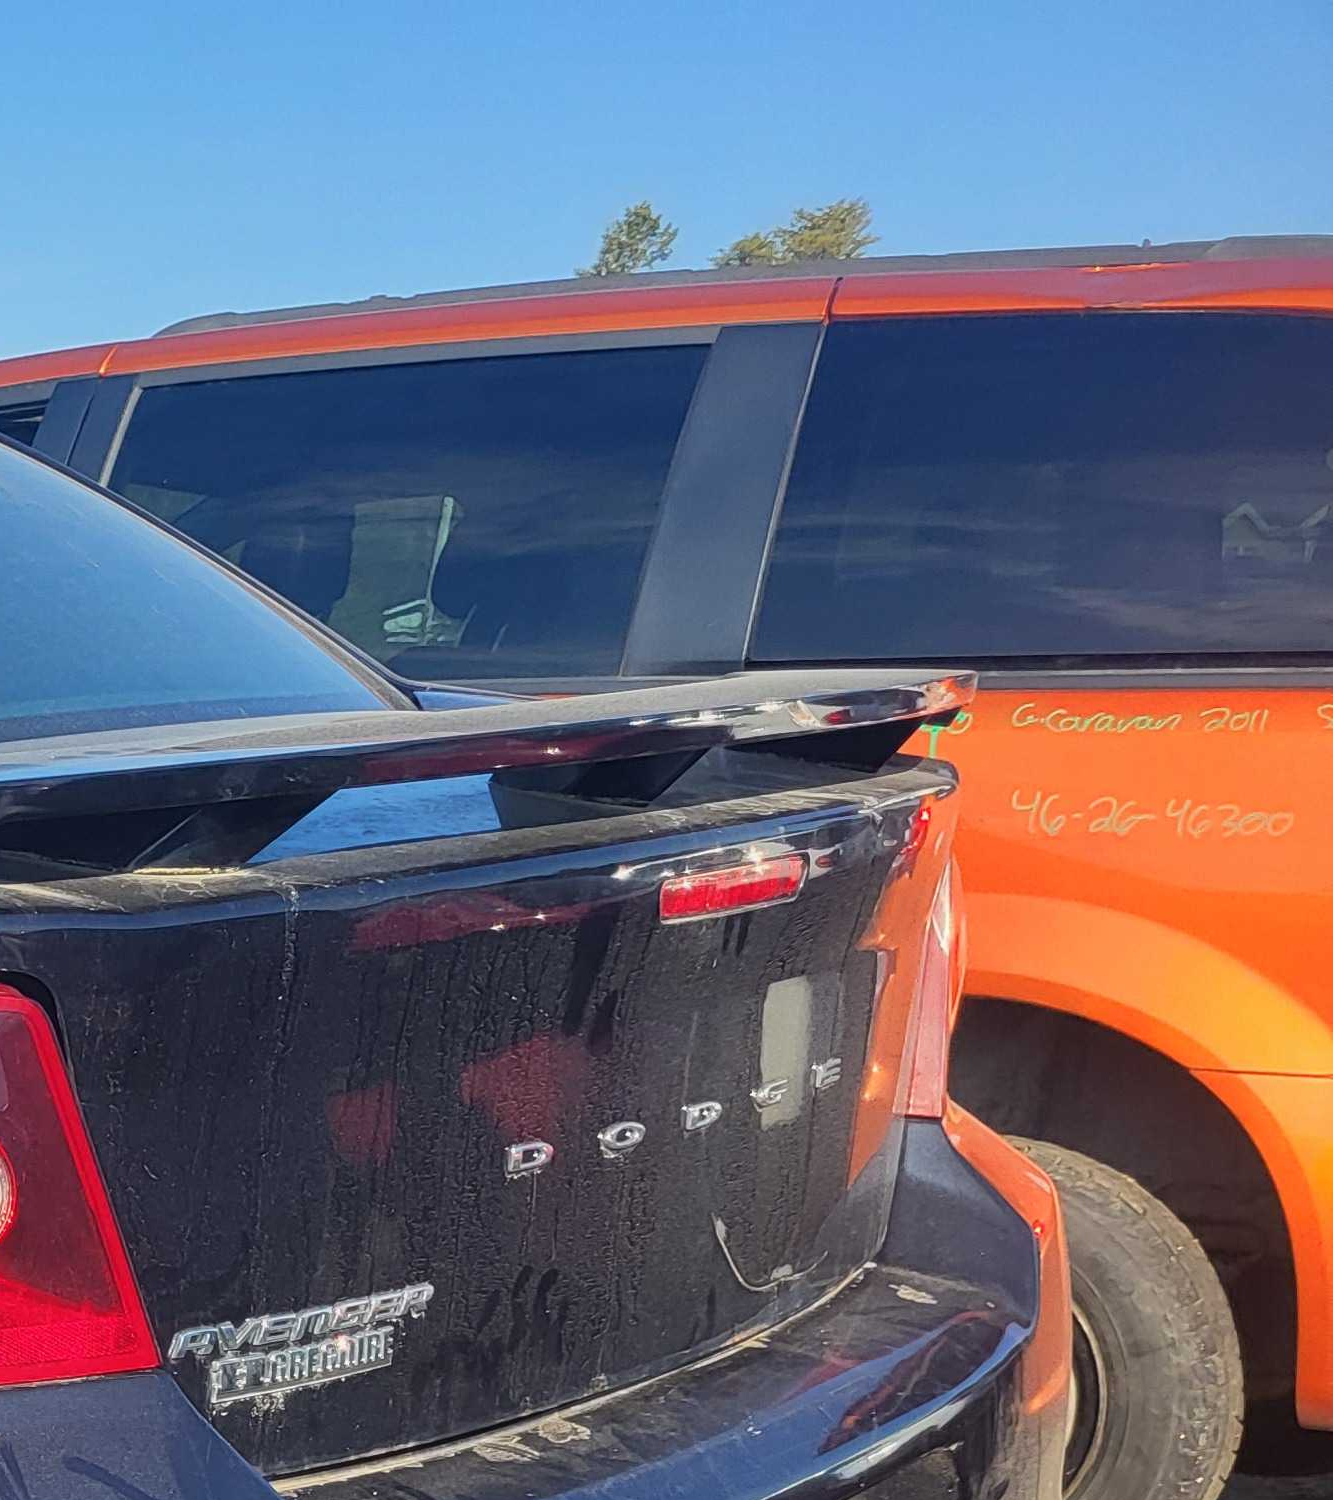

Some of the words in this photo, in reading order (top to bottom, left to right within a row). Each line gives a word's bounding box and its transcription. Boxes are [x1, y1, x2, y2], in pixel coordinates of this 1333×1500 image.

[1198, 706, 1269, 733] 2011
[505, 1057, 842, 1180] DODGE
[167, 1281, 435, 1360] AVENGER
